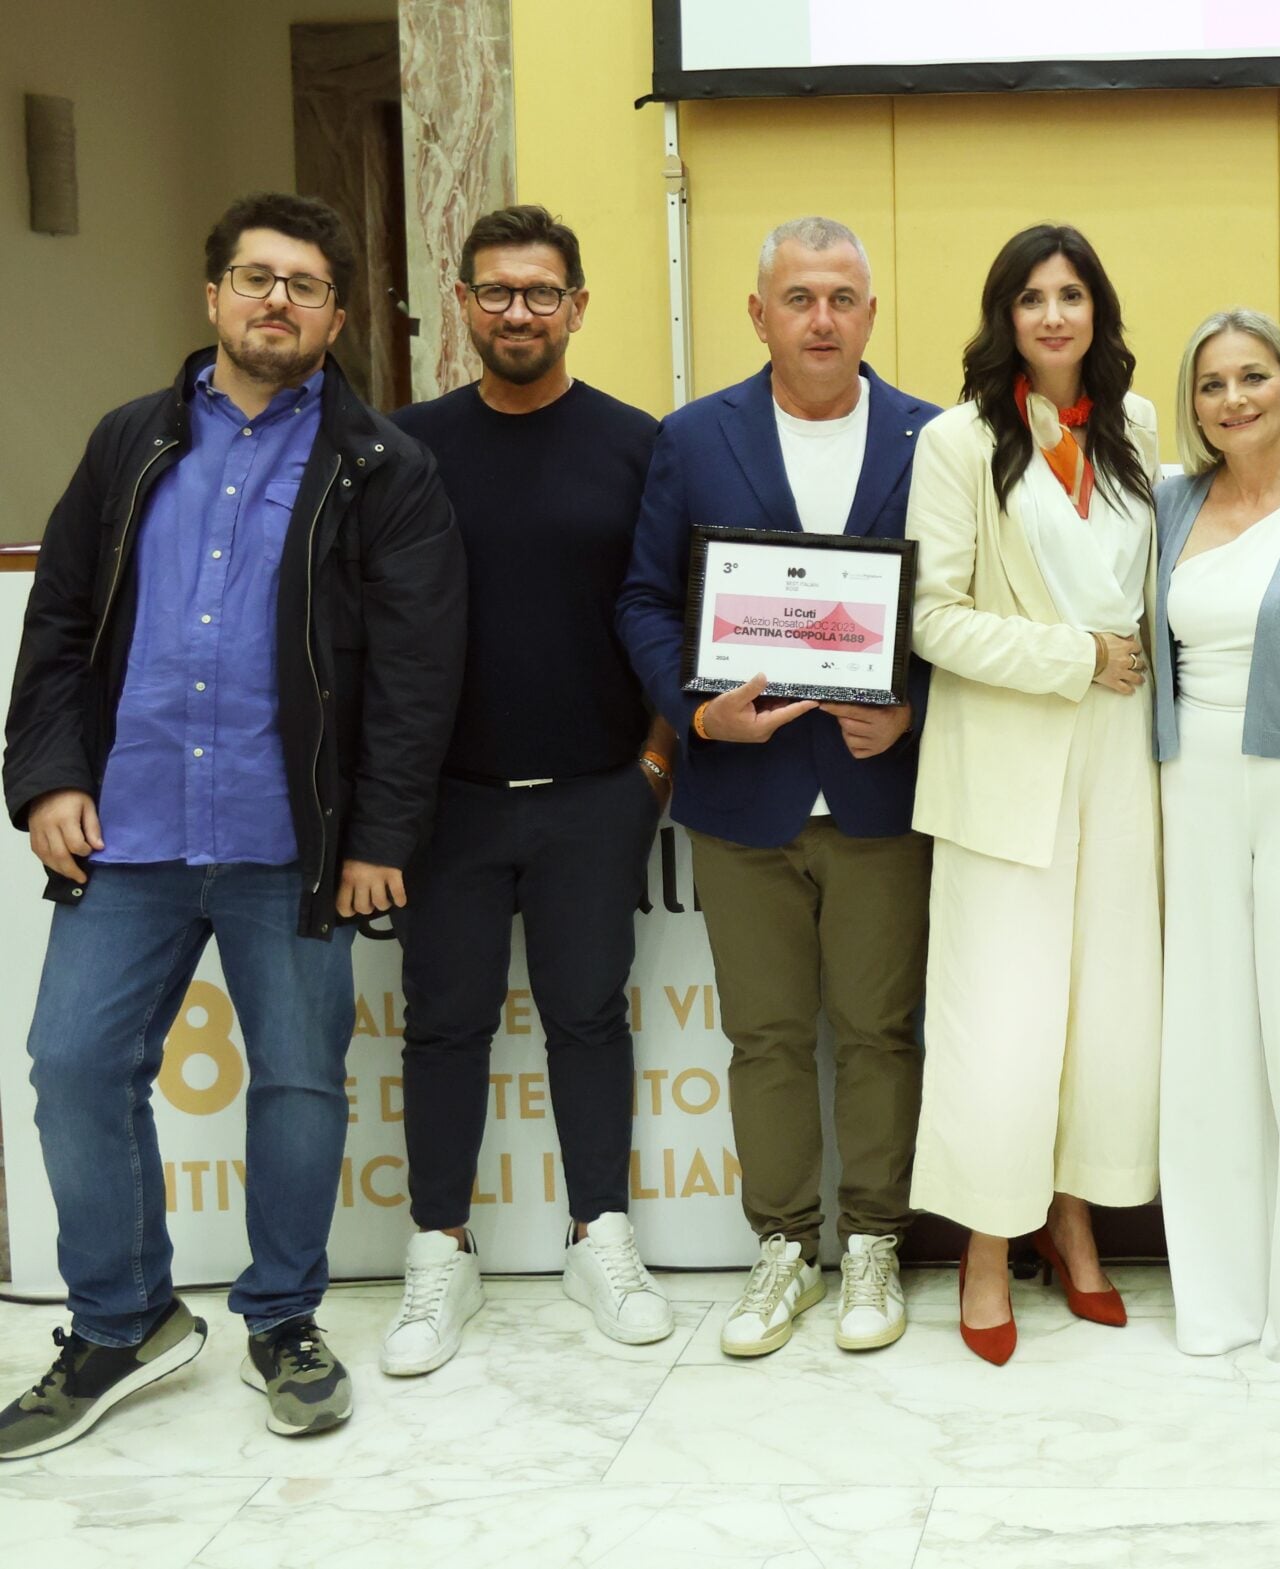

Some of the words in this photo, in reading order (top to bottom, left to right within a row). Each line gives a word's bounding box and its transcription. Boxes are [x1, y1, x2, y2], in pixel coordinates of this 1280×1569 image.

[723, 562, 739, 574] 3°
[784, 608, 793, 617] Li
[795, 608, 816, 619] Cuti
[743, 616, 771, 627] Alezio
[772, 617, 804, 629] Rosato
[805, 620, 829, 630] DOC
[830, 622, 856, 632] 2023
[733, 627, 783, 639] CANTINA
[784, 629, 837, 642] COPPOLA
[839, 633, 865, 644] 1489
